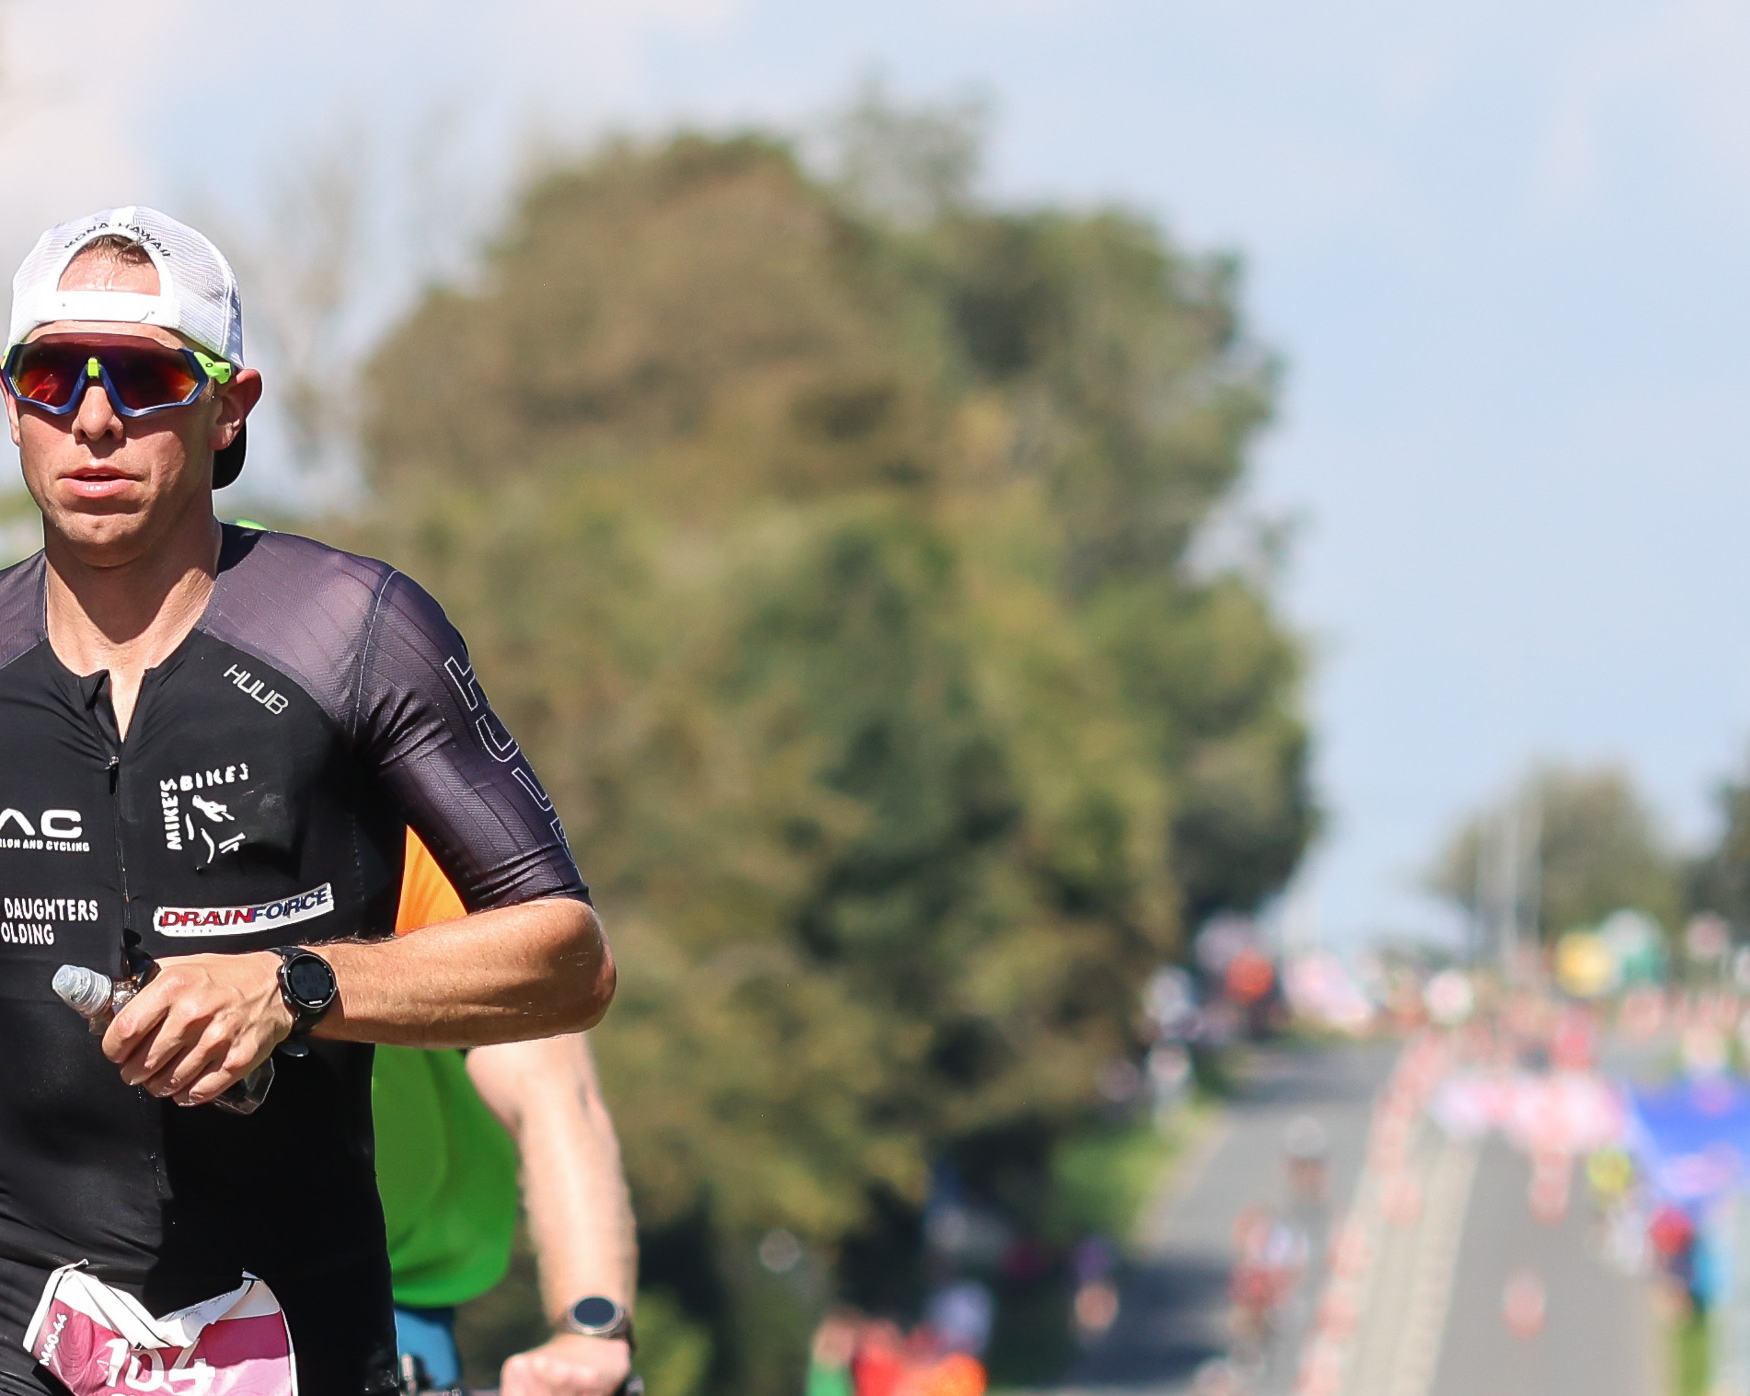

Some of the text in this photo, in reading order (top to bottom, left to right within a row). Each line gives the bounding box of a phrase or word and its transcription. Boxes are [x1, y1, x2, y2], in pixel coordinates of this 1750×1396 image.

[223, 663, 289, 715] HUUB
[159, 762, 249, 850] MIKE'S BIKES
[22, 839, 44, 850] AND
[45, 840, 90, 852] CYCLING
[4, 897, 99, 922] DAUGHTERS
[159, 887, 330, 927] DRAINFORCE
[38, 1313, 68, 1367] M40-44
